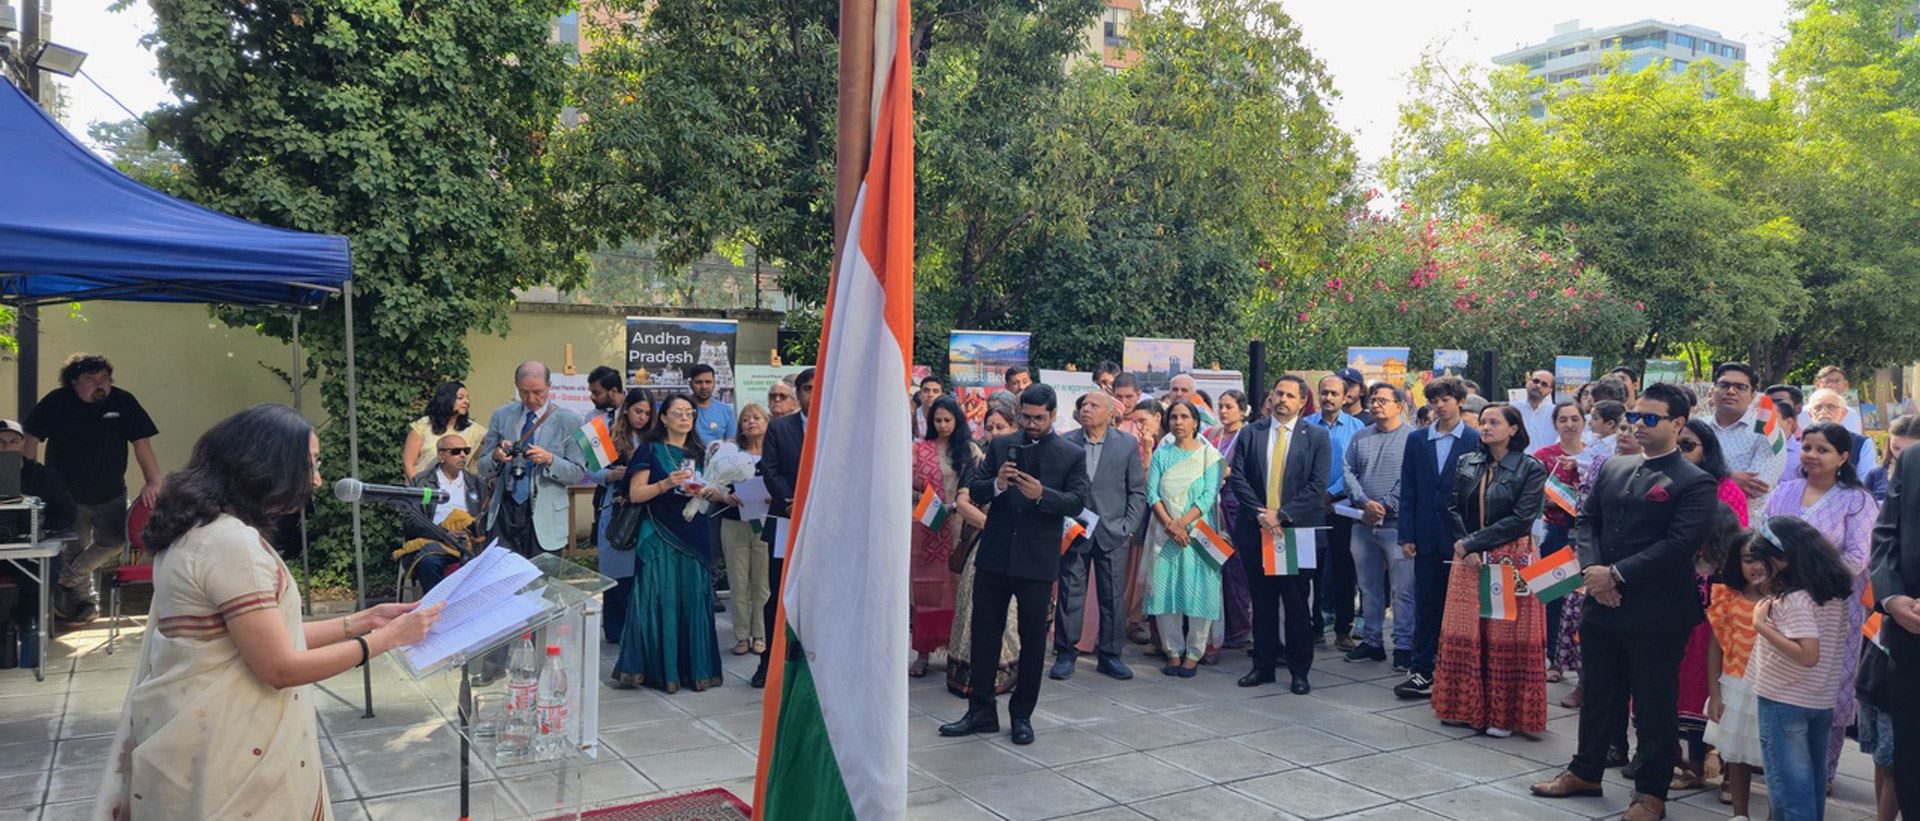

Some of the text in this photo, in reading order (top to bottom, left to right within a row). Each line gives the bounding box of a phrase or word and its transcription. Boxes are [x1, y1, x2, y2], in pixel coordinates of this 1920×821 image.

[632, 331, 691, 345] Andhra
[629, 350, 694, 364] Pradesh
[954, 370, 984, 382] West
